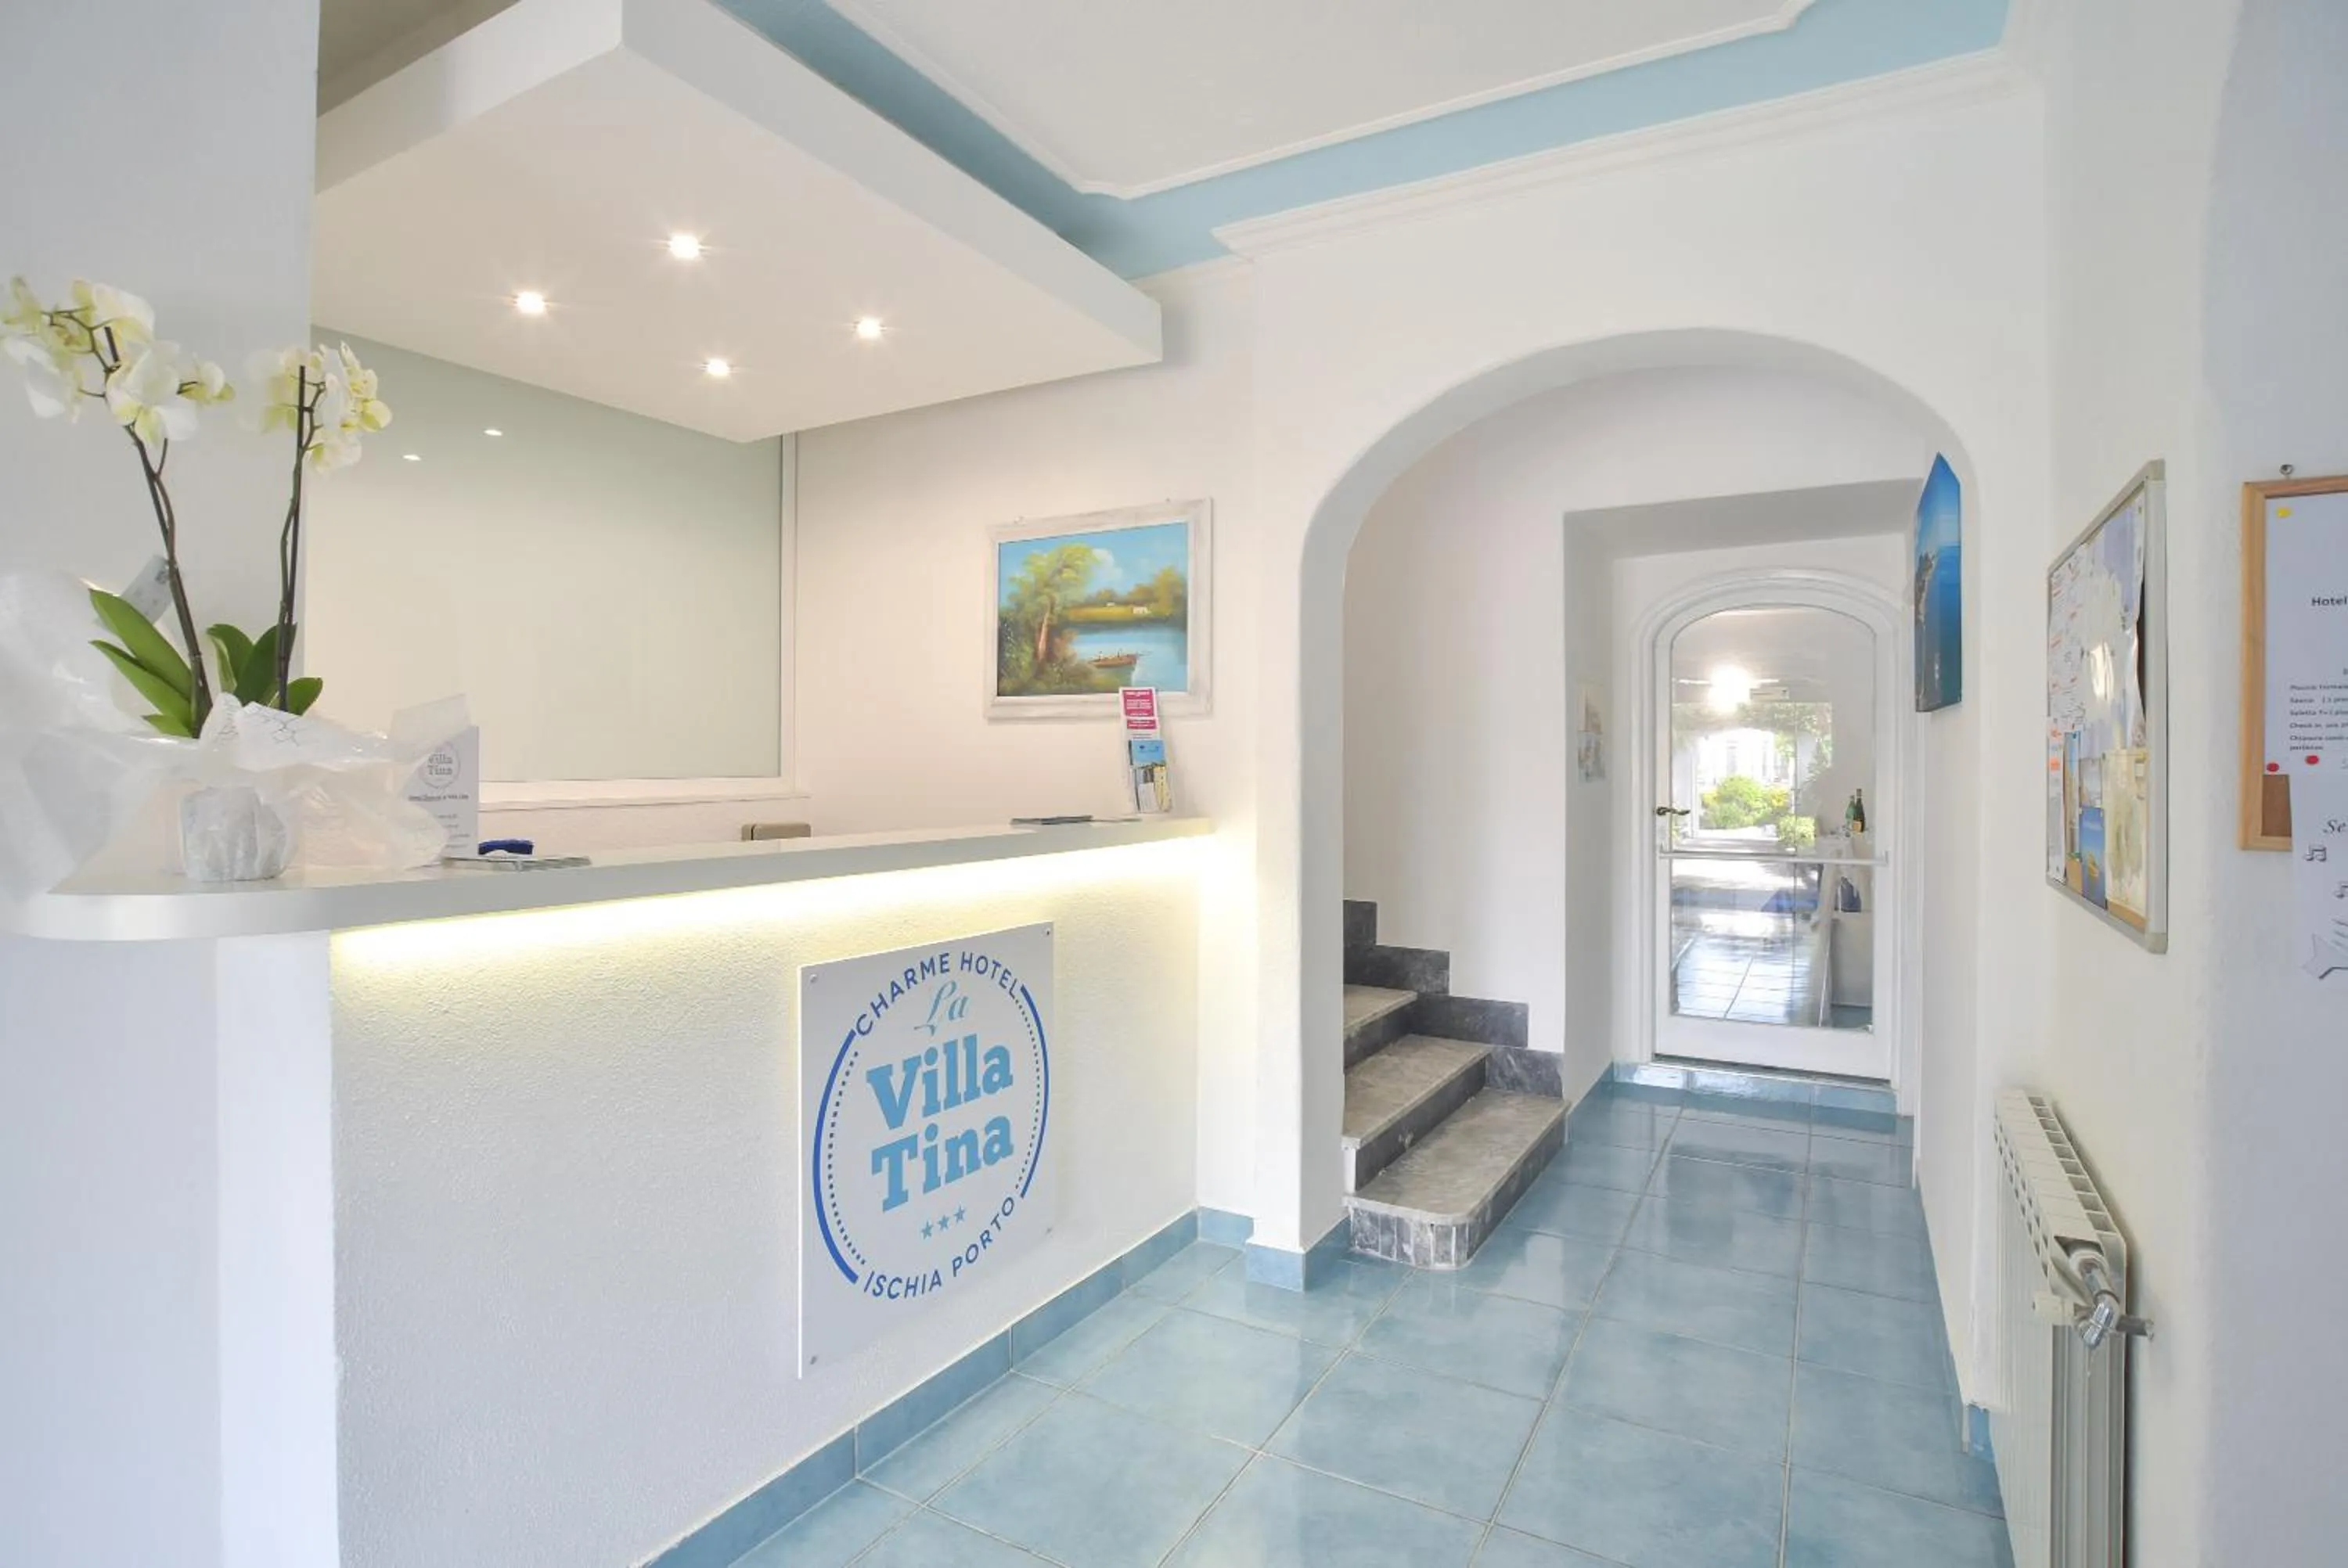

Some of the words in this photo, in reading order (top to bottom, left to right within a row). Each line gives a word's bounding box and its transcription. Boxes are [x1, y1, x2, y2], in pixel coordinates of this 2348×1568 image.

[2311, 596, 2347, 606] Hotel
[856, 952, 950, 1036] CHARME
[960, 951, 1018, 999] HOTEL
[913, 980, 969, 1037] La
[866, 1033, 1014, 1130] Villa
[870, 1114, 1014, 1213] Tina
[863, 1268, 942, 1299] ISCHIA
[952, 1196, 1014, 1277] PORTO
